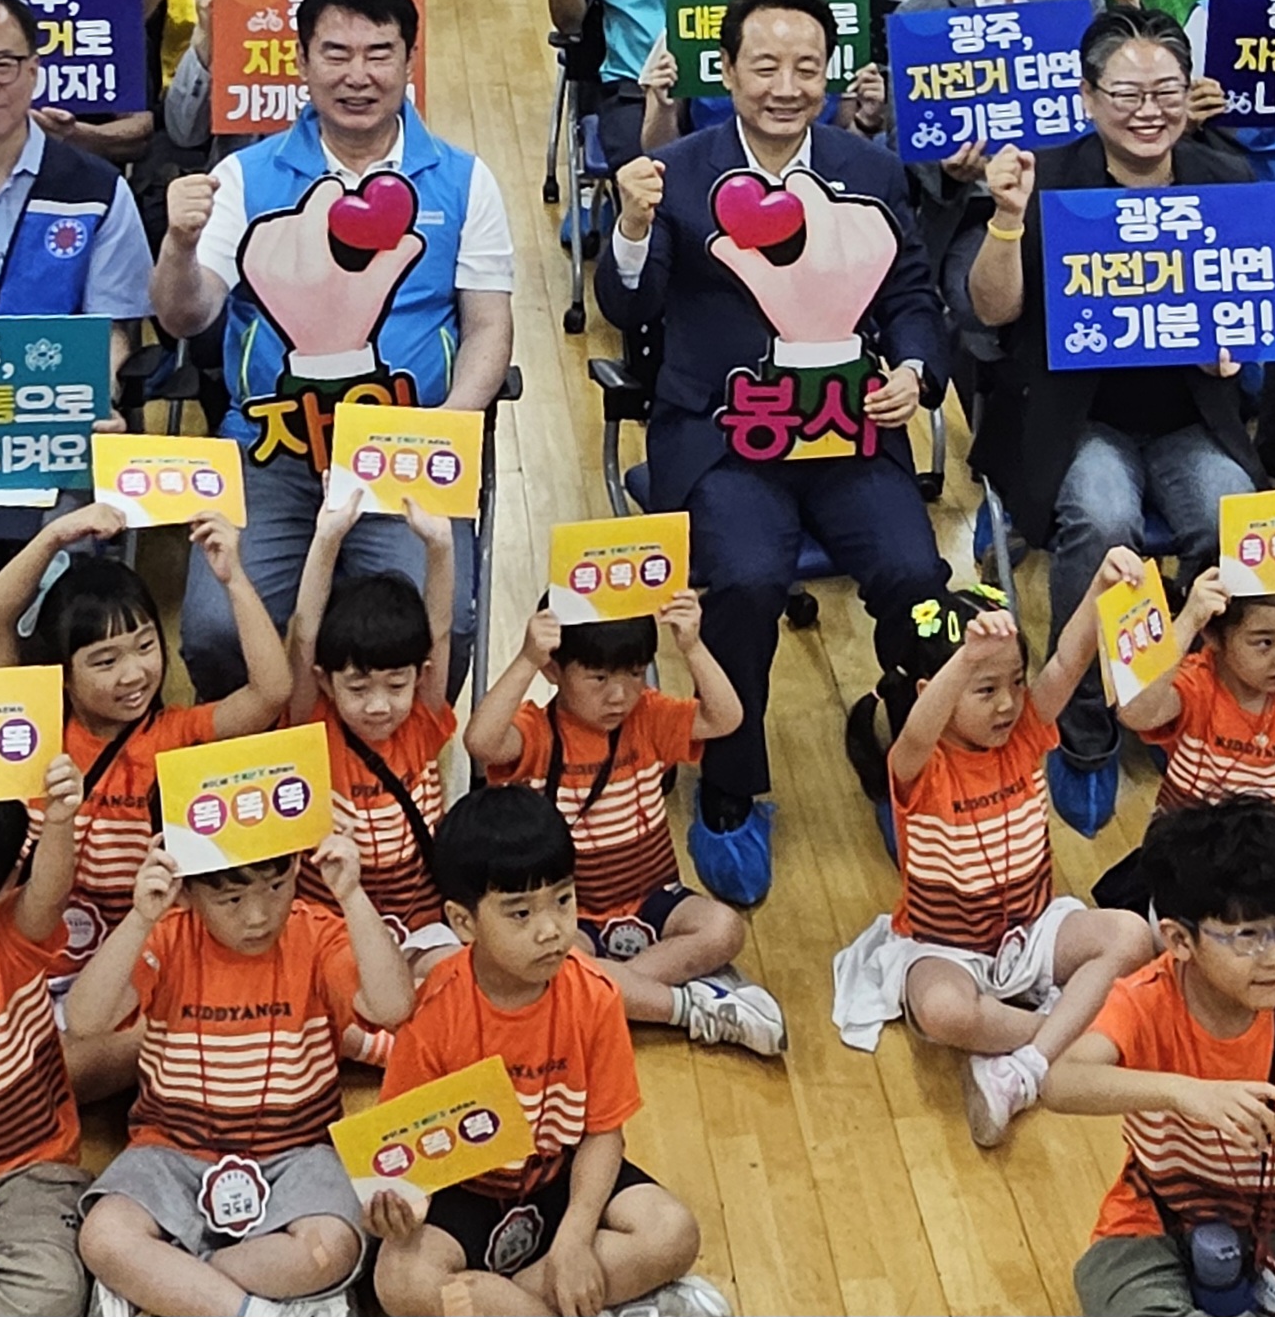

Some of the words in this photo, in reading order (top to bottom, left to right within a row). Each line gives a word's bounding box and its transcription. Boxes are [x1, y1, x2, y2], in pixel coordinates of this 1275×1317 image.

[947, 11, 1033, 53] 광주,
[907, 64, 1009, 101] 자전거
[1014, 51, 1083, 91] 타면
[952, 102, 1023, 144] 기분
[1034, 95, 1090, 136] 업!
[1115, 195, 1217, 246] 광주,
[1062, 251, 1184, 297] 자전거
[1193, 245, 1275, 291] 타면
[1113, 306, 1201, 349] 기분
[1215, 298, 1275, 348] 업!
[721, 373, 882, 462] 봉사
